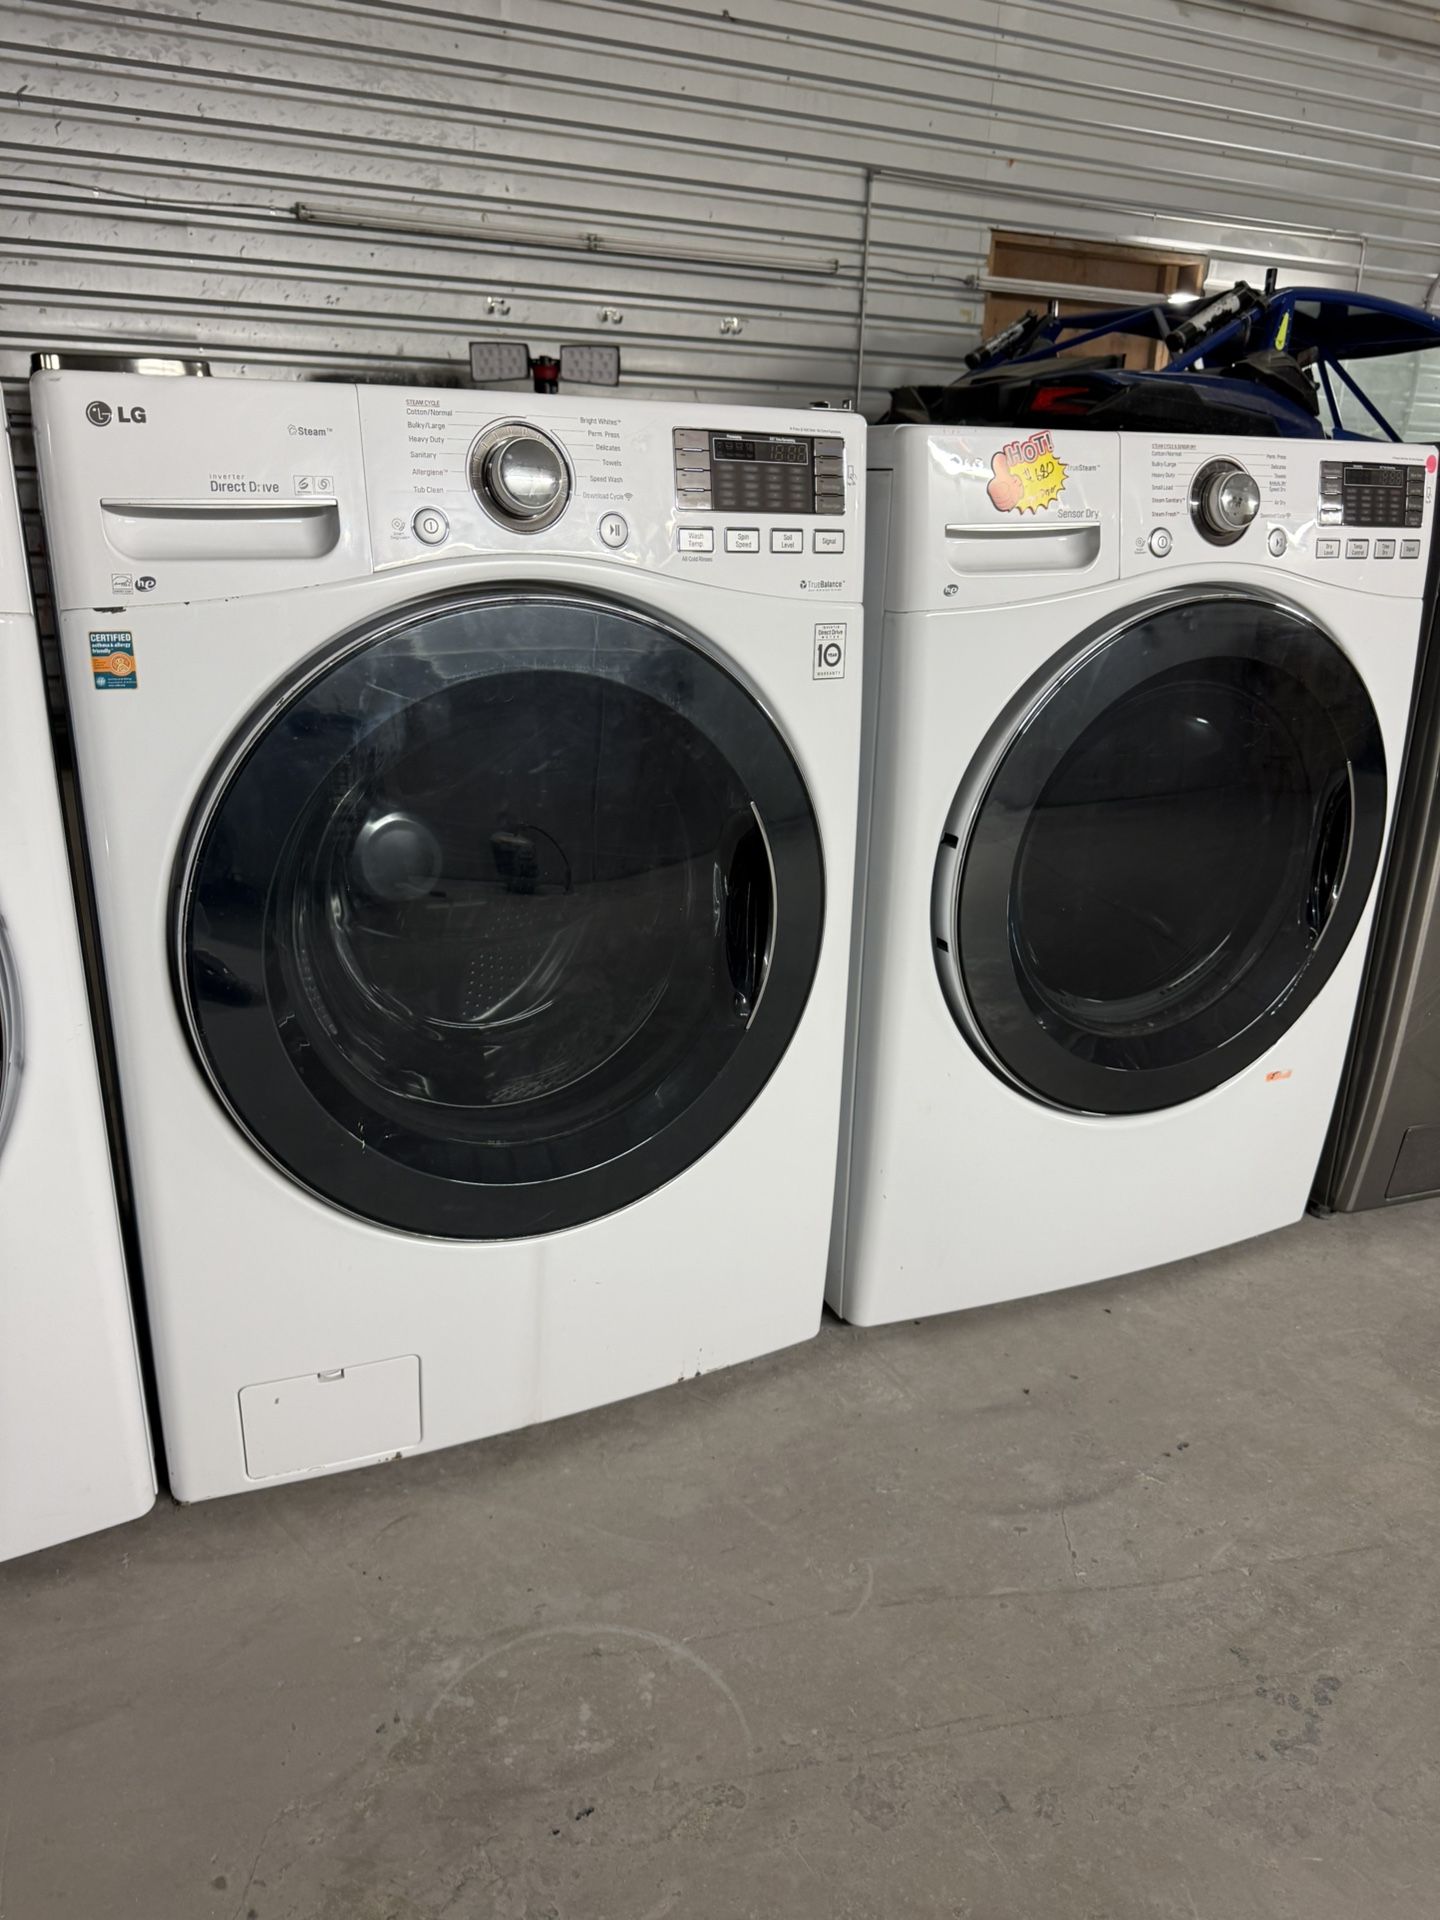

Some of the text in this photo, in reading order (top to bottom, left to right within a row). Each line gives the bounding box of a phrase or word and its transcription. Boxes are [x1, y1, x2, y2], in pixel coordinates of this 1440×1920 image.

[117, 406, 147, 424] LG
[406, 408, 452, 416] Cotton/Normal
[407, 421, 445, 430] Bulky/Large
[409, 436, 444, 444] Heavy Duty
[1006, 432, 1053, 467] HOT!
[410, 451, 437, 459] Sanitary
[210, 480, 246, 493] Direct
[1057, 508, 1099, 519] Sensor Dry
[737, 533, 749, 541] Spin
[822, 537, 836, 545] Signal
[735, 541, 752, 549] Speed
[91, 634, 131, 642] CERTIFIED
[817, 643, 842, 667] 10
